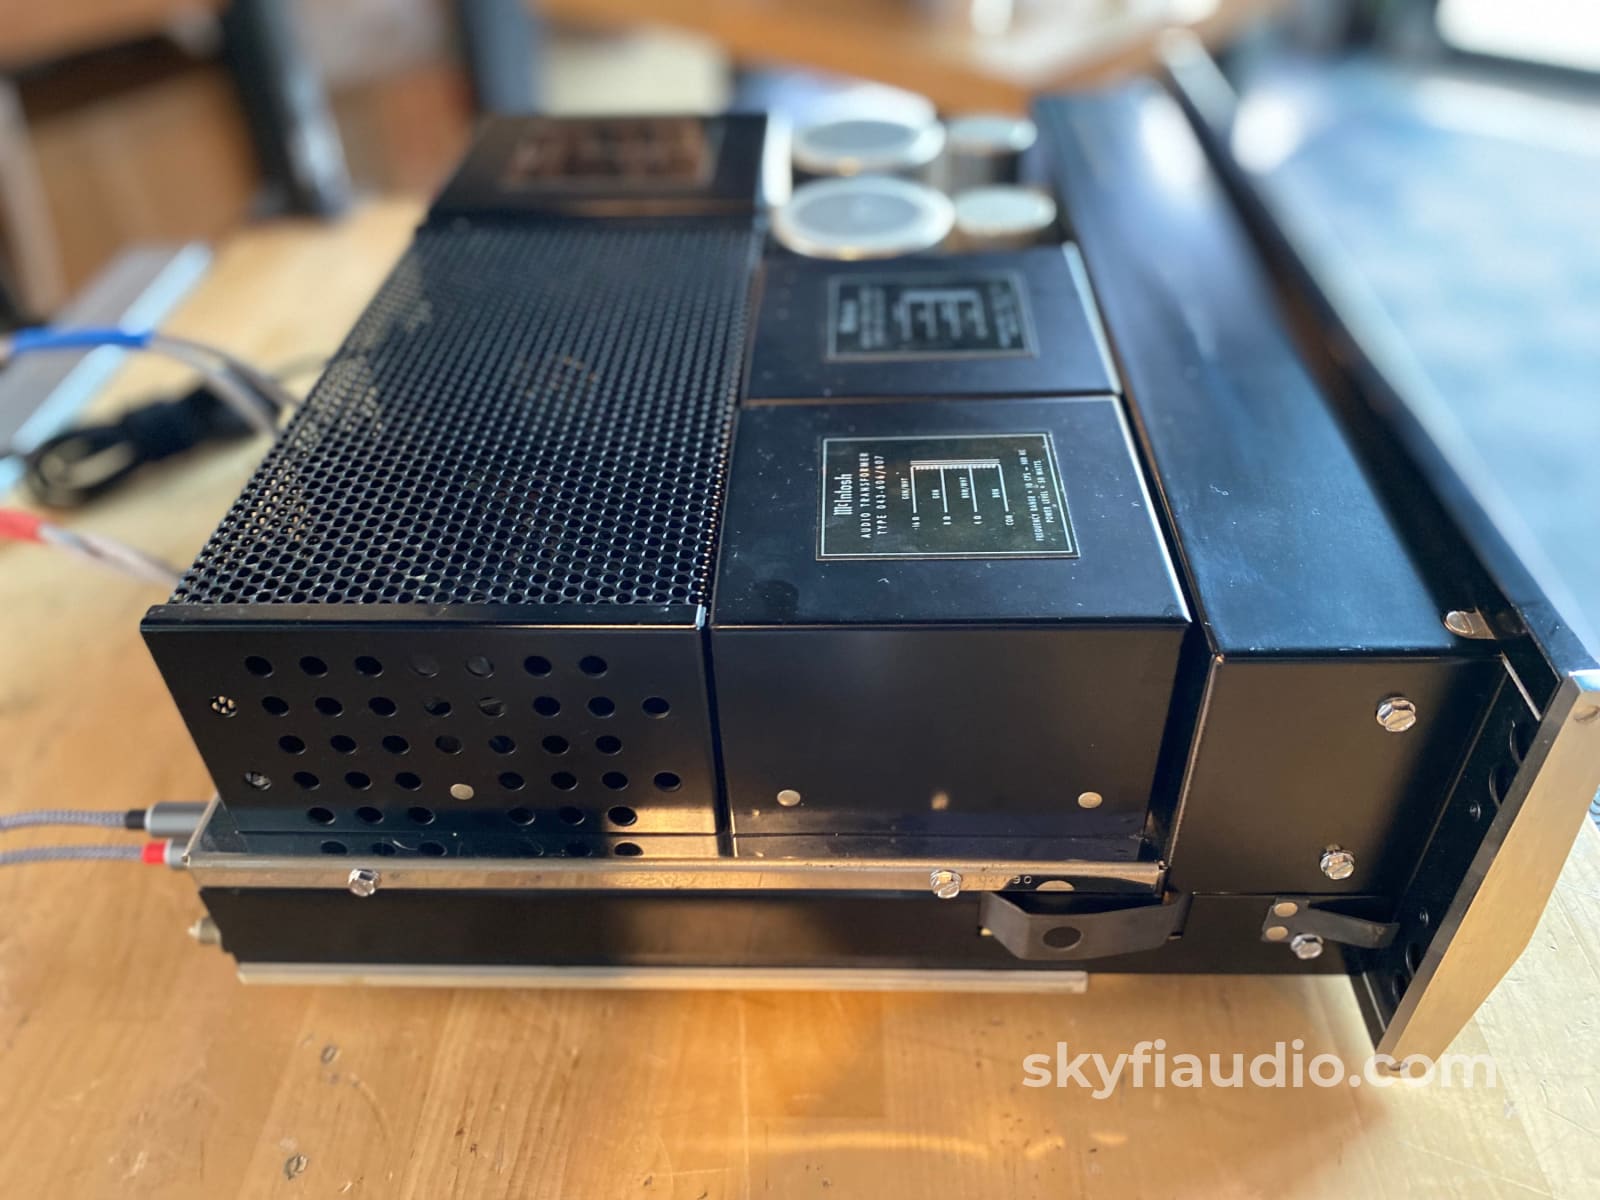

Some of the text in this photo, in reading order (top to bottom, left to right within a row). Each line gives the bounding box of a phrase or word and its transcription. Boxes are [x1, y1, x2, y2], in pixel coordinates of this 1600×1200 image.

[833, 474, 853, 516] McIntosh
[859, 453, 872, 538] AUDIO TRANSFORMER
[876, 515, 888, 534] TYPE
